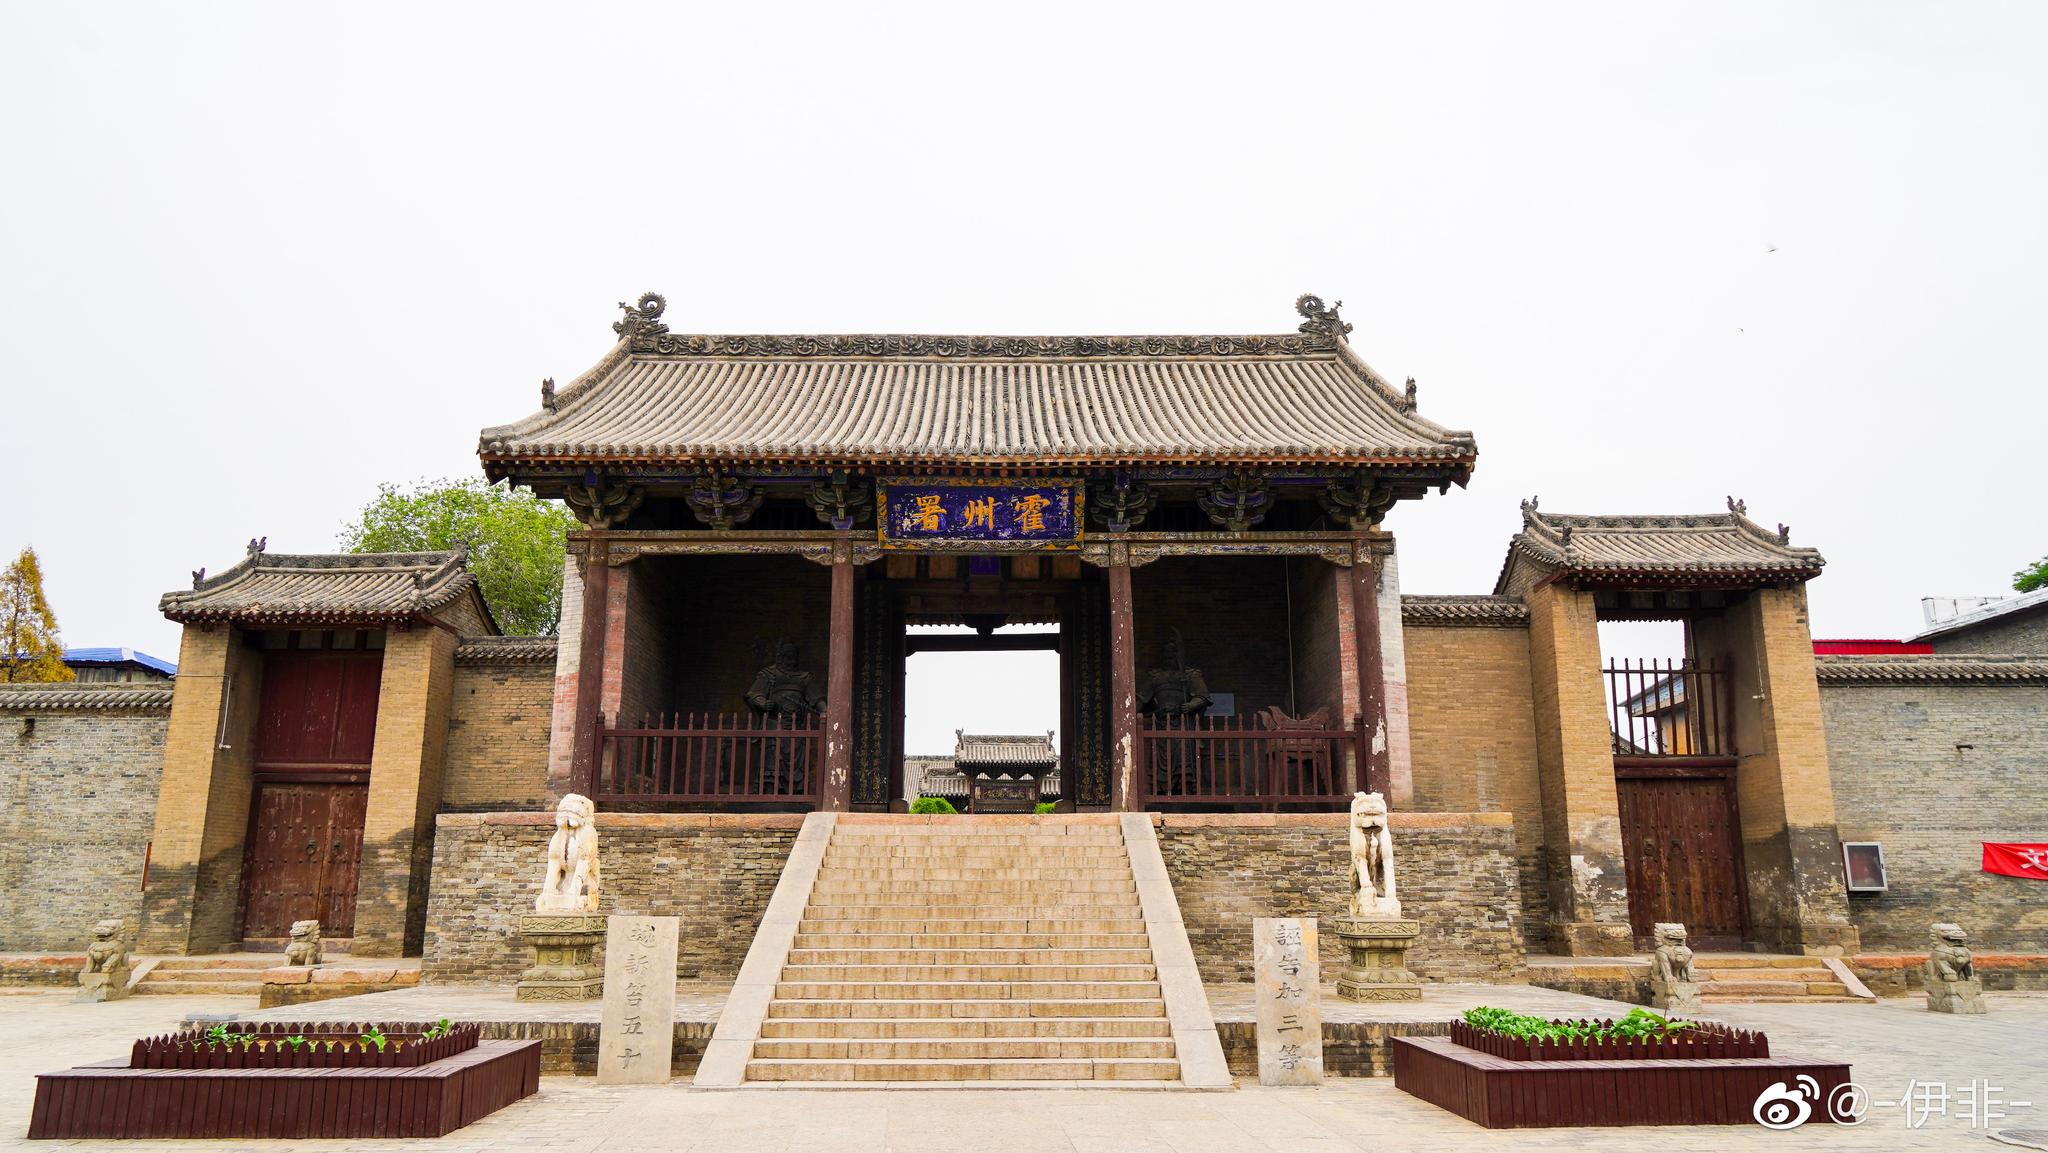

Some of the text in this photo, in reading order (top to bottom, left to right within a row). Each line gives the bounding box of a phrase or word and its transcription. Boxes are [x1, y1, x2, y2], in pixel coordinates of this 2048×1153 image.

[912, 494, 1051, 534] 霍州署
[2017, 848, 2048, 871] 文
